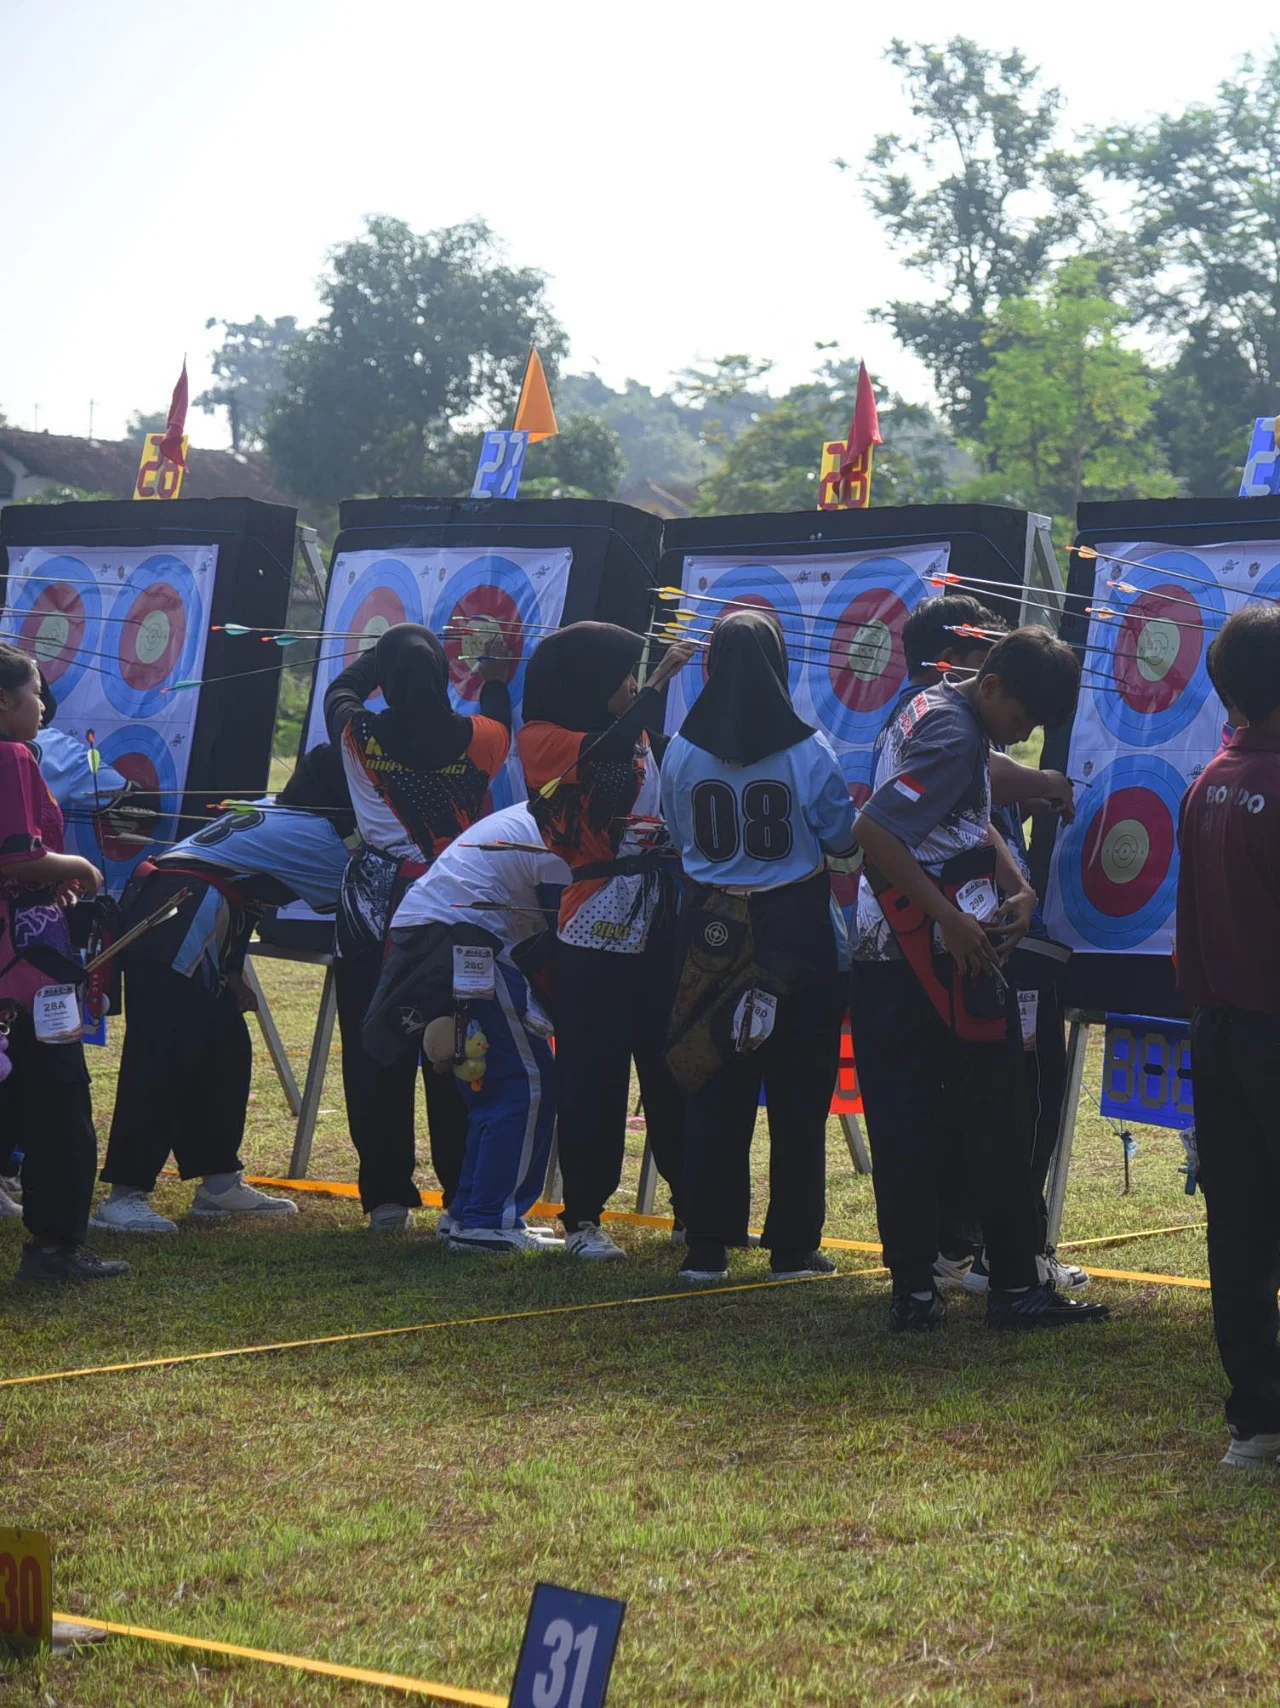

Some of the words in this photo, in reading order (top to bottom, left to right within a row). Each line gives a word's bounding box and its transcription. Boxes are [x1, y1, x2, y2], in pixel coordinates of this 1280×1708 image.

[471, 433, 524, 499] 27
[691, 778, 793, 863] 08
[44, 1001, 67, 1012] 28A
[0, 1552, 43, 1639] 30
[532, 1618, 598, 1708] 31
